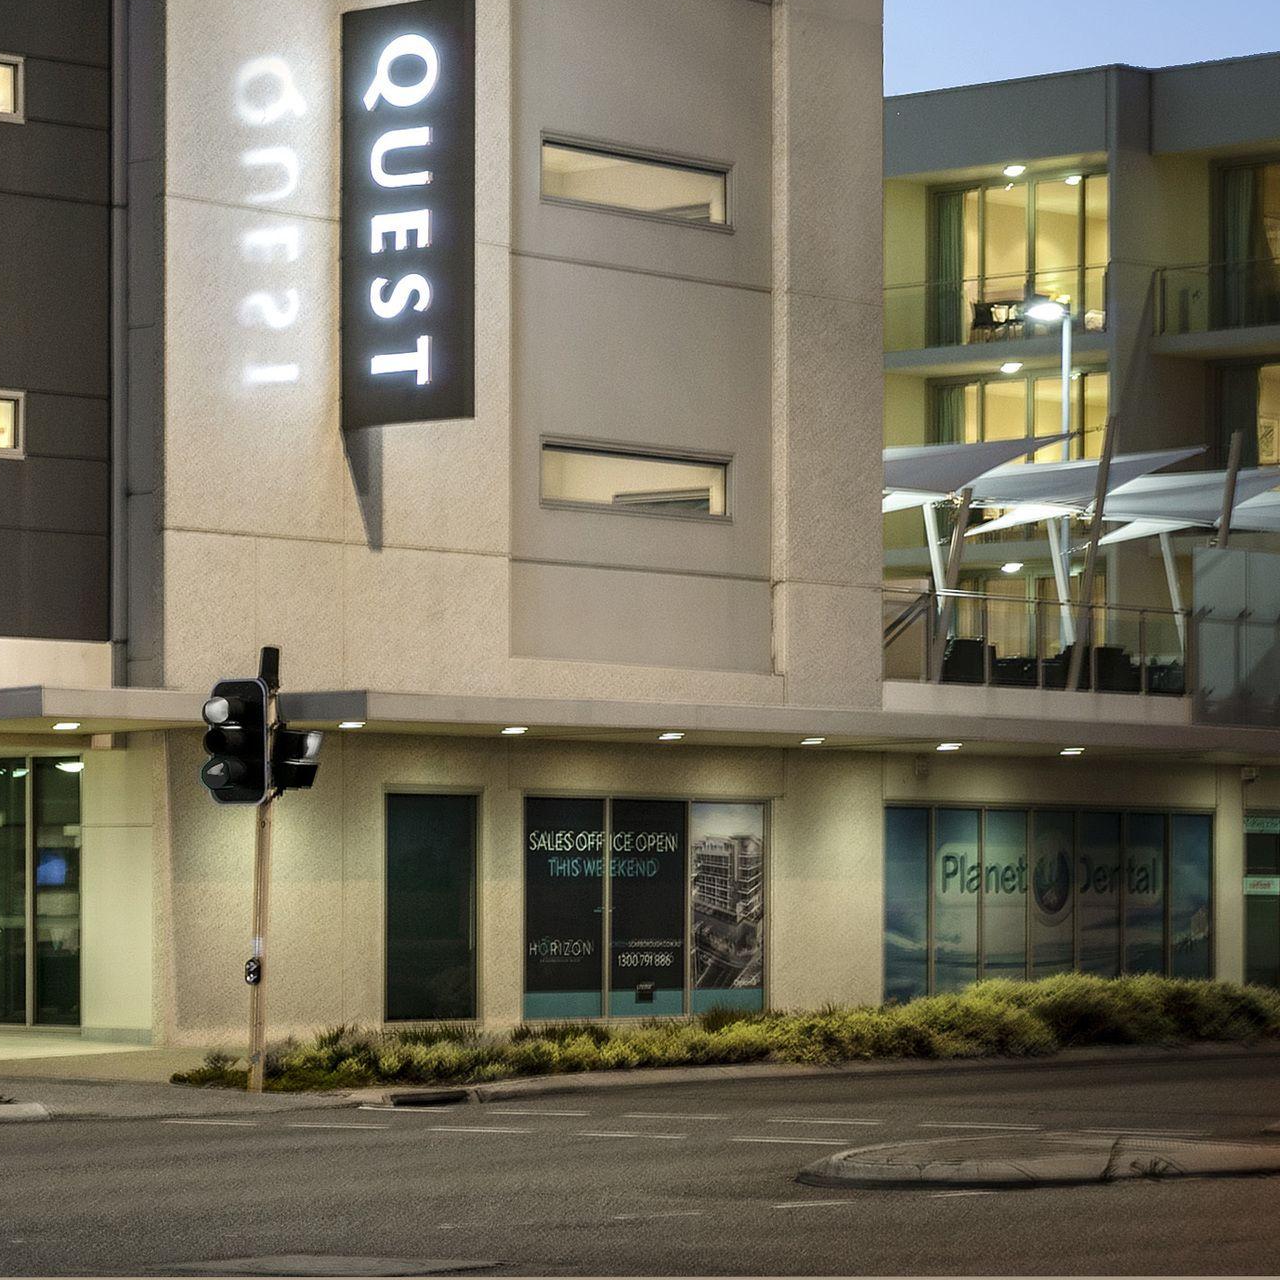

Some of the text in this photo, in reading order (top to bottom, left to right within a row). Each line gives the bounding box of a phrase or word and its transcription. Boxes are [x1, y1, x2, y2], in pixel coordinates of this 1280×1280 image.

[362, 33, 439, 385] QUEST
[529, 831, 677, 853] SALES OFFICE OPEN
[548, 858, 659, 878] THIS WEEKEND
[941, 854, 1028, 894] Planet
[529, 941, 592, 956] HORIZON
